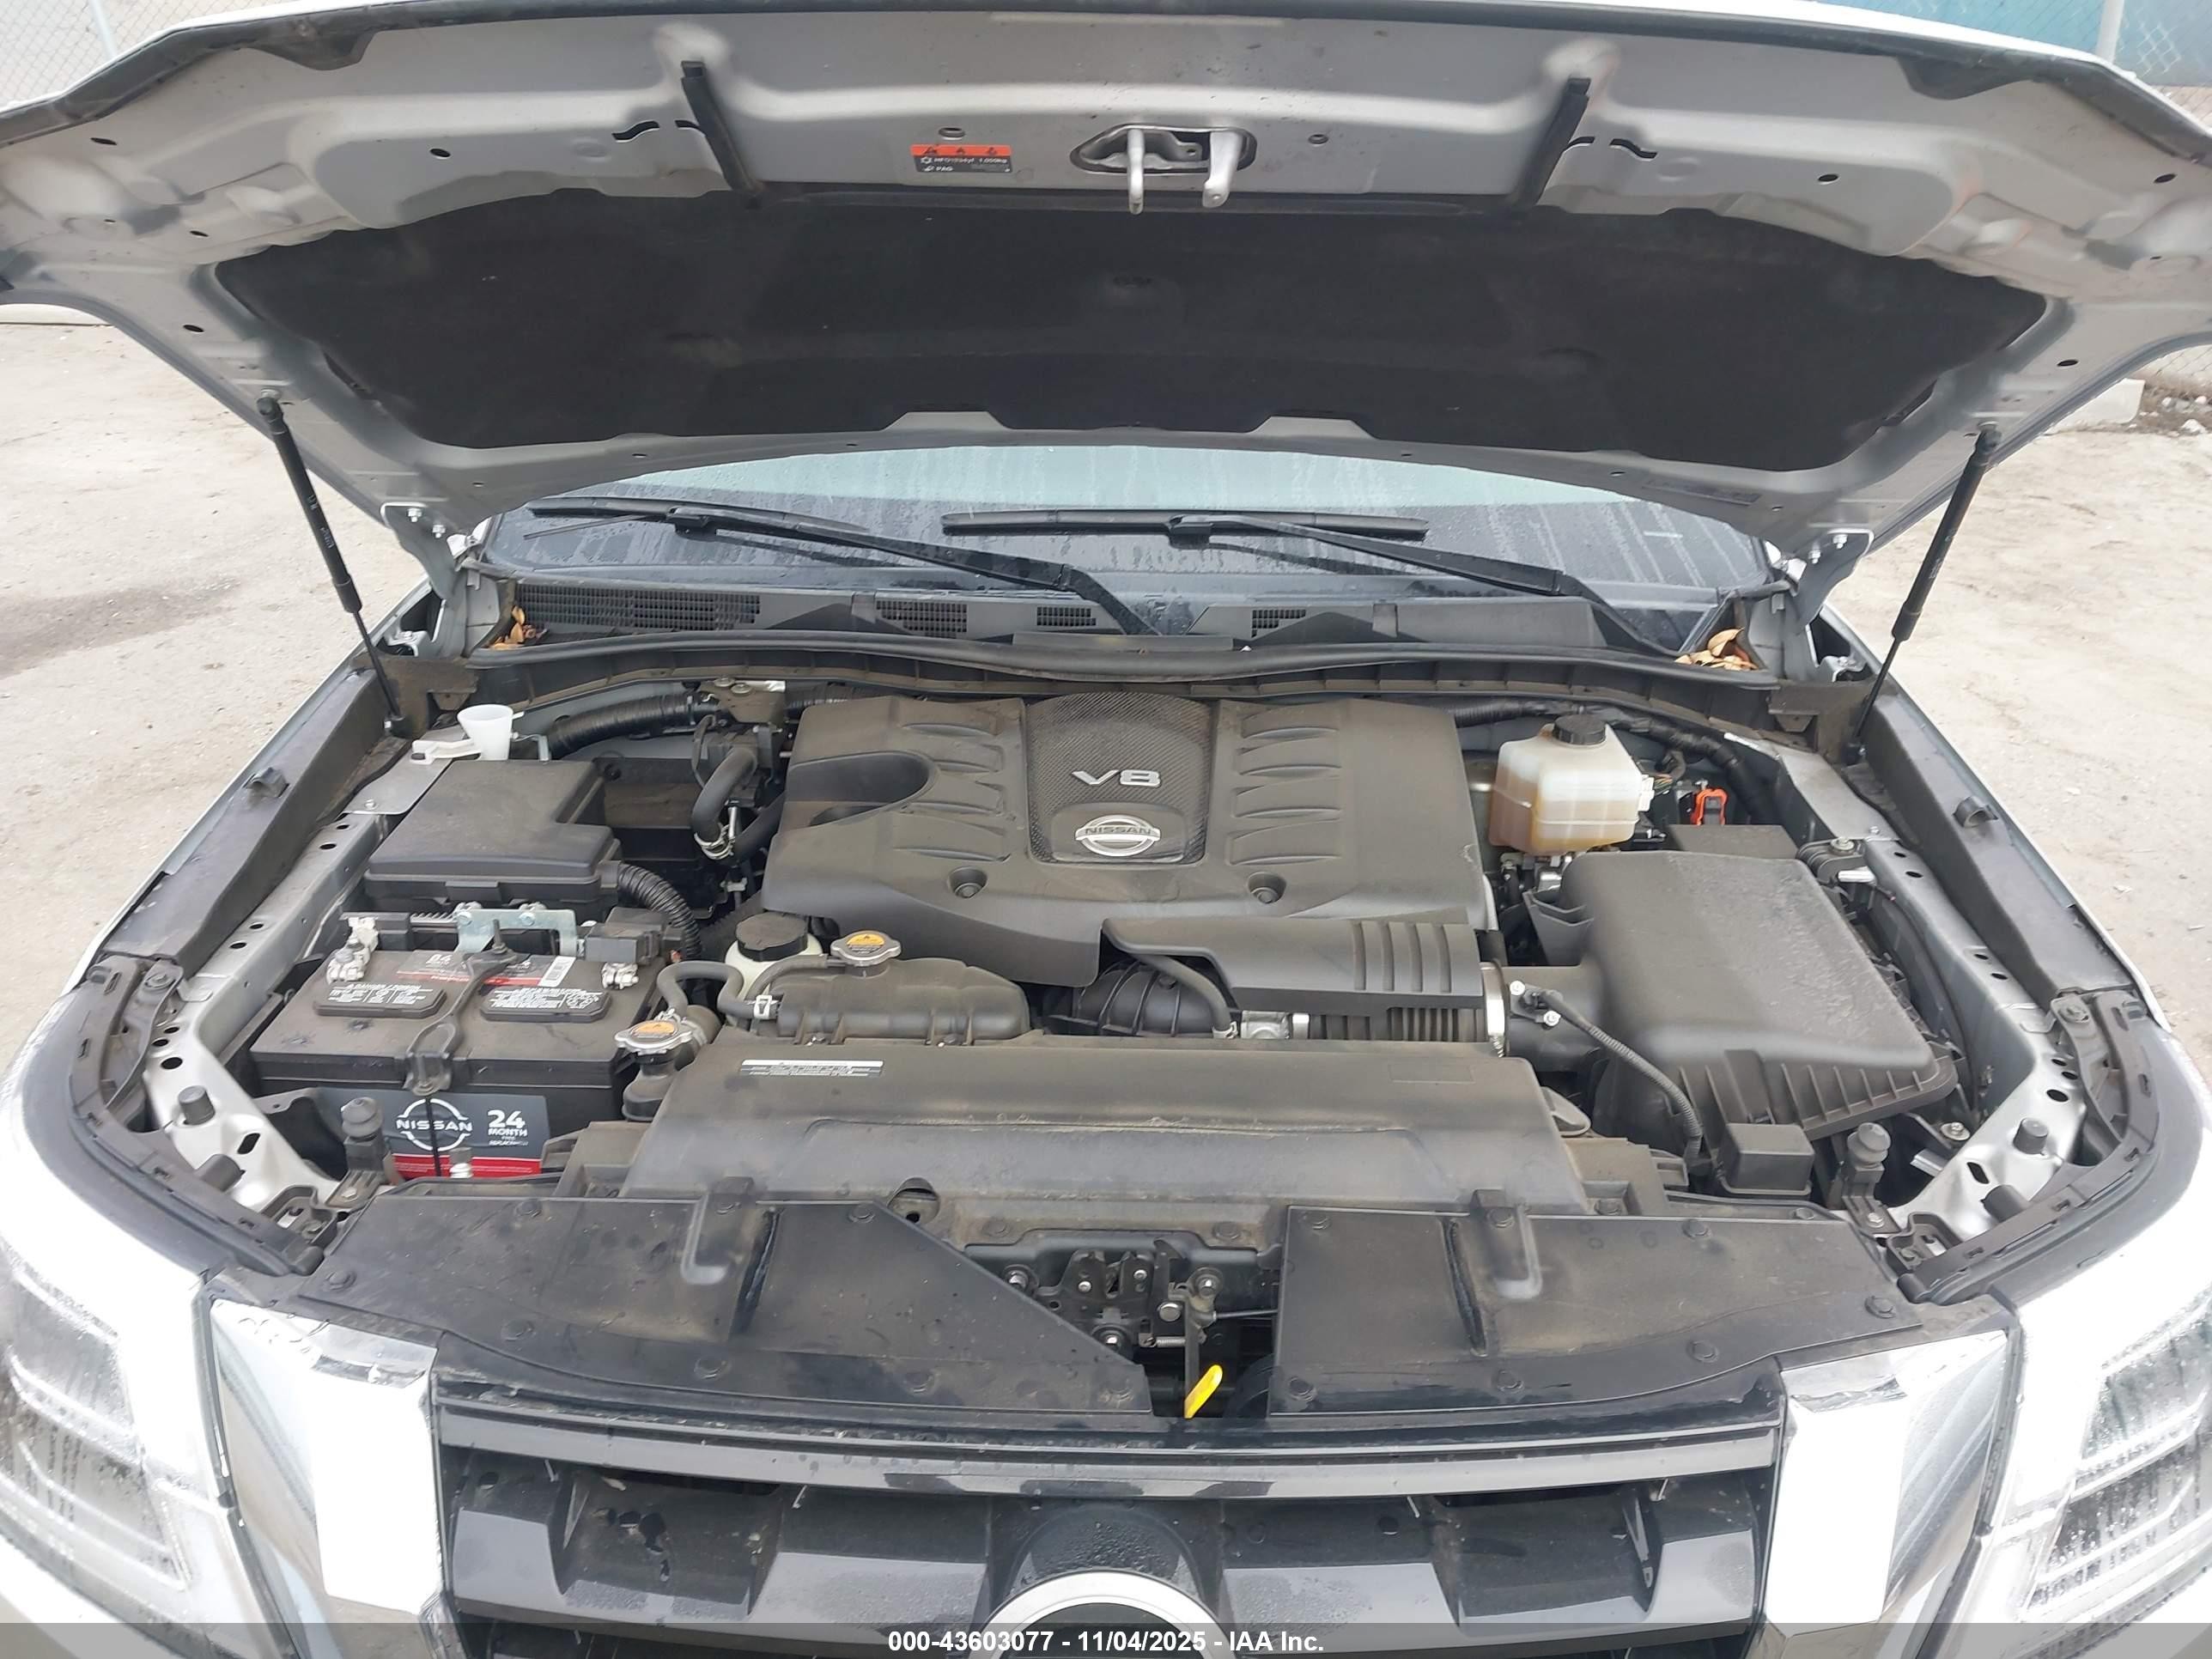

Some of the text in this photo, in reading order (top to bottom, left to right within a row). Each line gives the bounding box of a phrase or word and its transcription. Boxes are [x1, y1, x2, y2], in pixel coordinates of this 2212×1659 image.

[1072, 769, 1161, 787] V8
[1085, 825, 1152, 836] NISSAN
[396, 1119, 472, 1132] NISSAN
[487, 1109, 526, 1129] 24
[488, 1128, 528, 1137] MONTH
